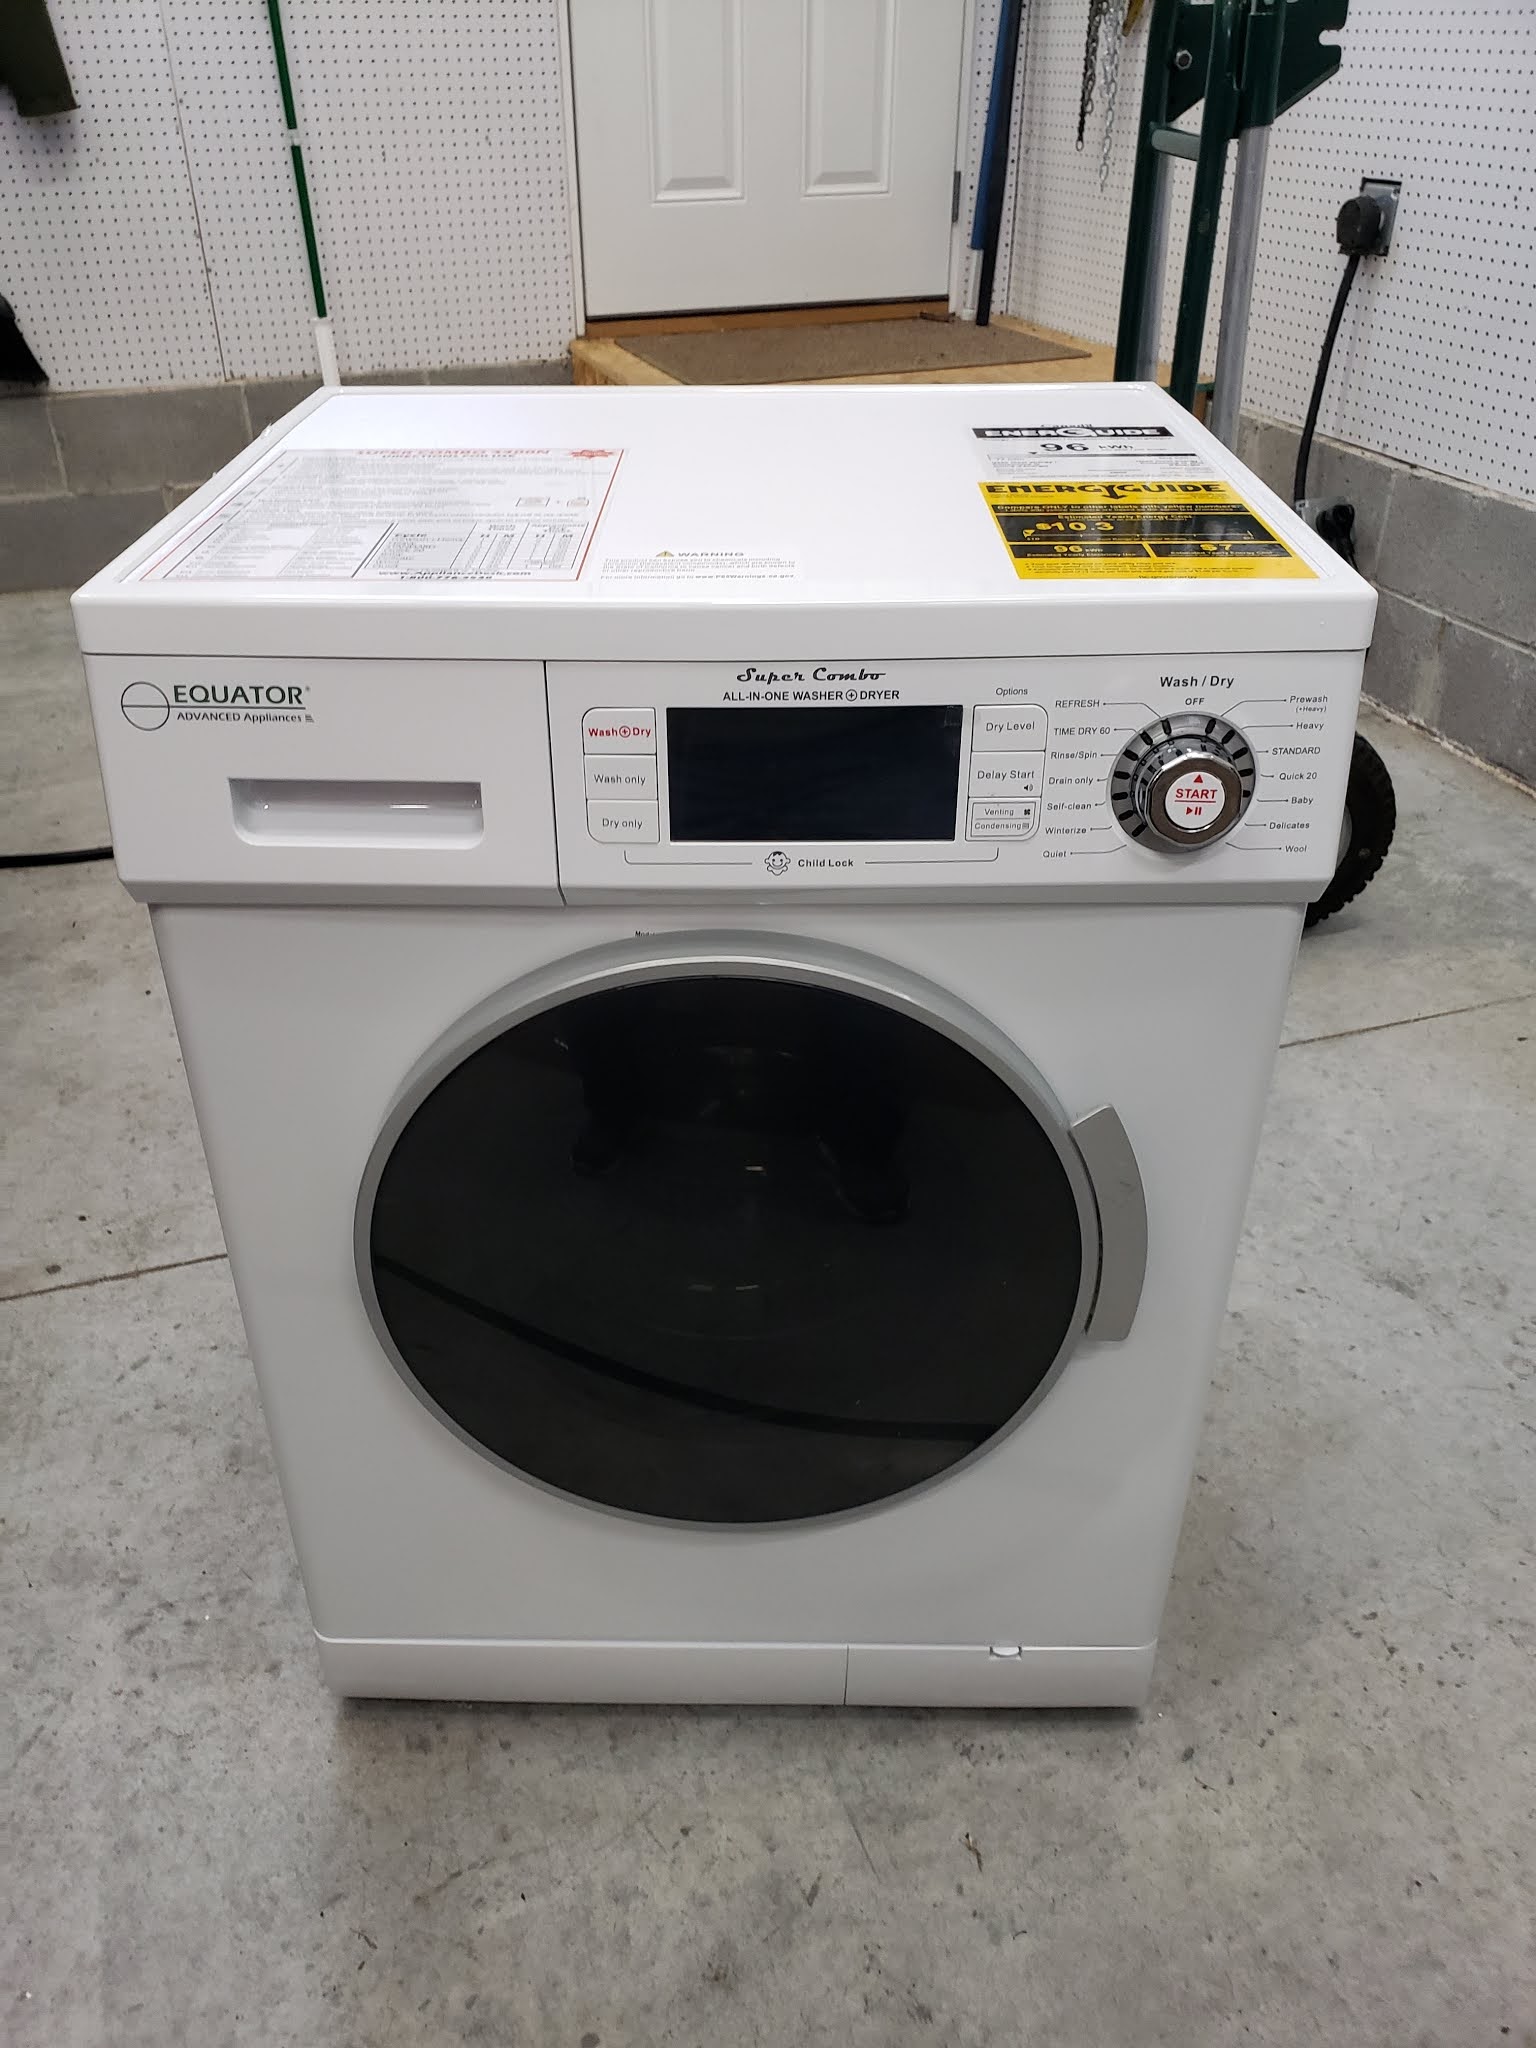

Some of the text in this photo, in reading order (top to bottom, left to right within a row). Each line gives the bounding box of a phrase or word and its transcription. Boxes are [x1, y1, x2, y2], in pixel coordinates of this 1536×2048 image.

[1040, 442, 1090, 451] 96
[736, 667, 887, 685] Super Combo
[1159, 676, 1198, 688] Wash
[1210, 675, 1235, 689] Dry
[173, 685, 303, 705] EQUATOR
[722, 689, 900, 701] ALL-IN-ONE WASHER DRYER
[995, 687, 1029, 697] Options
[1055, 699, 1100, 709] REFRESH
[1185, 697, 1205, 706] OFF
[1289, 695, 1328, 704] Prewash
[176, 711, 302, 724] ADVANCED Appliances
[986, 721, 1035, 733] Dry Level
[1054, 726, 1111, 736] TIME DRY 60
[1296, 721, 1324, 732] Heavy
[588, 726, 651, 740] Wash Dry
[1272, 746, 1321, 755] STANDARD
[1050, 751, 1098, 761] Rinse/Spin
[594, 774, 646, 786] Wash only
[977, 769, 1035, 781] Delay Start
[1279, 771, 1318, 781] Quick 20
[1048, 776, 1094, 786] Drain only
[1175, 788, 1218, 799] START
[1291, 796, 1313, 806] Baby
[1046, 802, 1092, 811] Self-clean
[984, 808, 1014, 818] Venting
[602, 818, 643, 830] Dry only
[974, 821, 1022, 832] Condensing
[1269, 821, 1310, 830] Delicates
[1045, 826, 1087, 835] Winterize
[1285, 845, 1307, 853] Wool
[1042, 850, 1067, 859] Quiet
[797, 858, 854, 868] Child Lock
